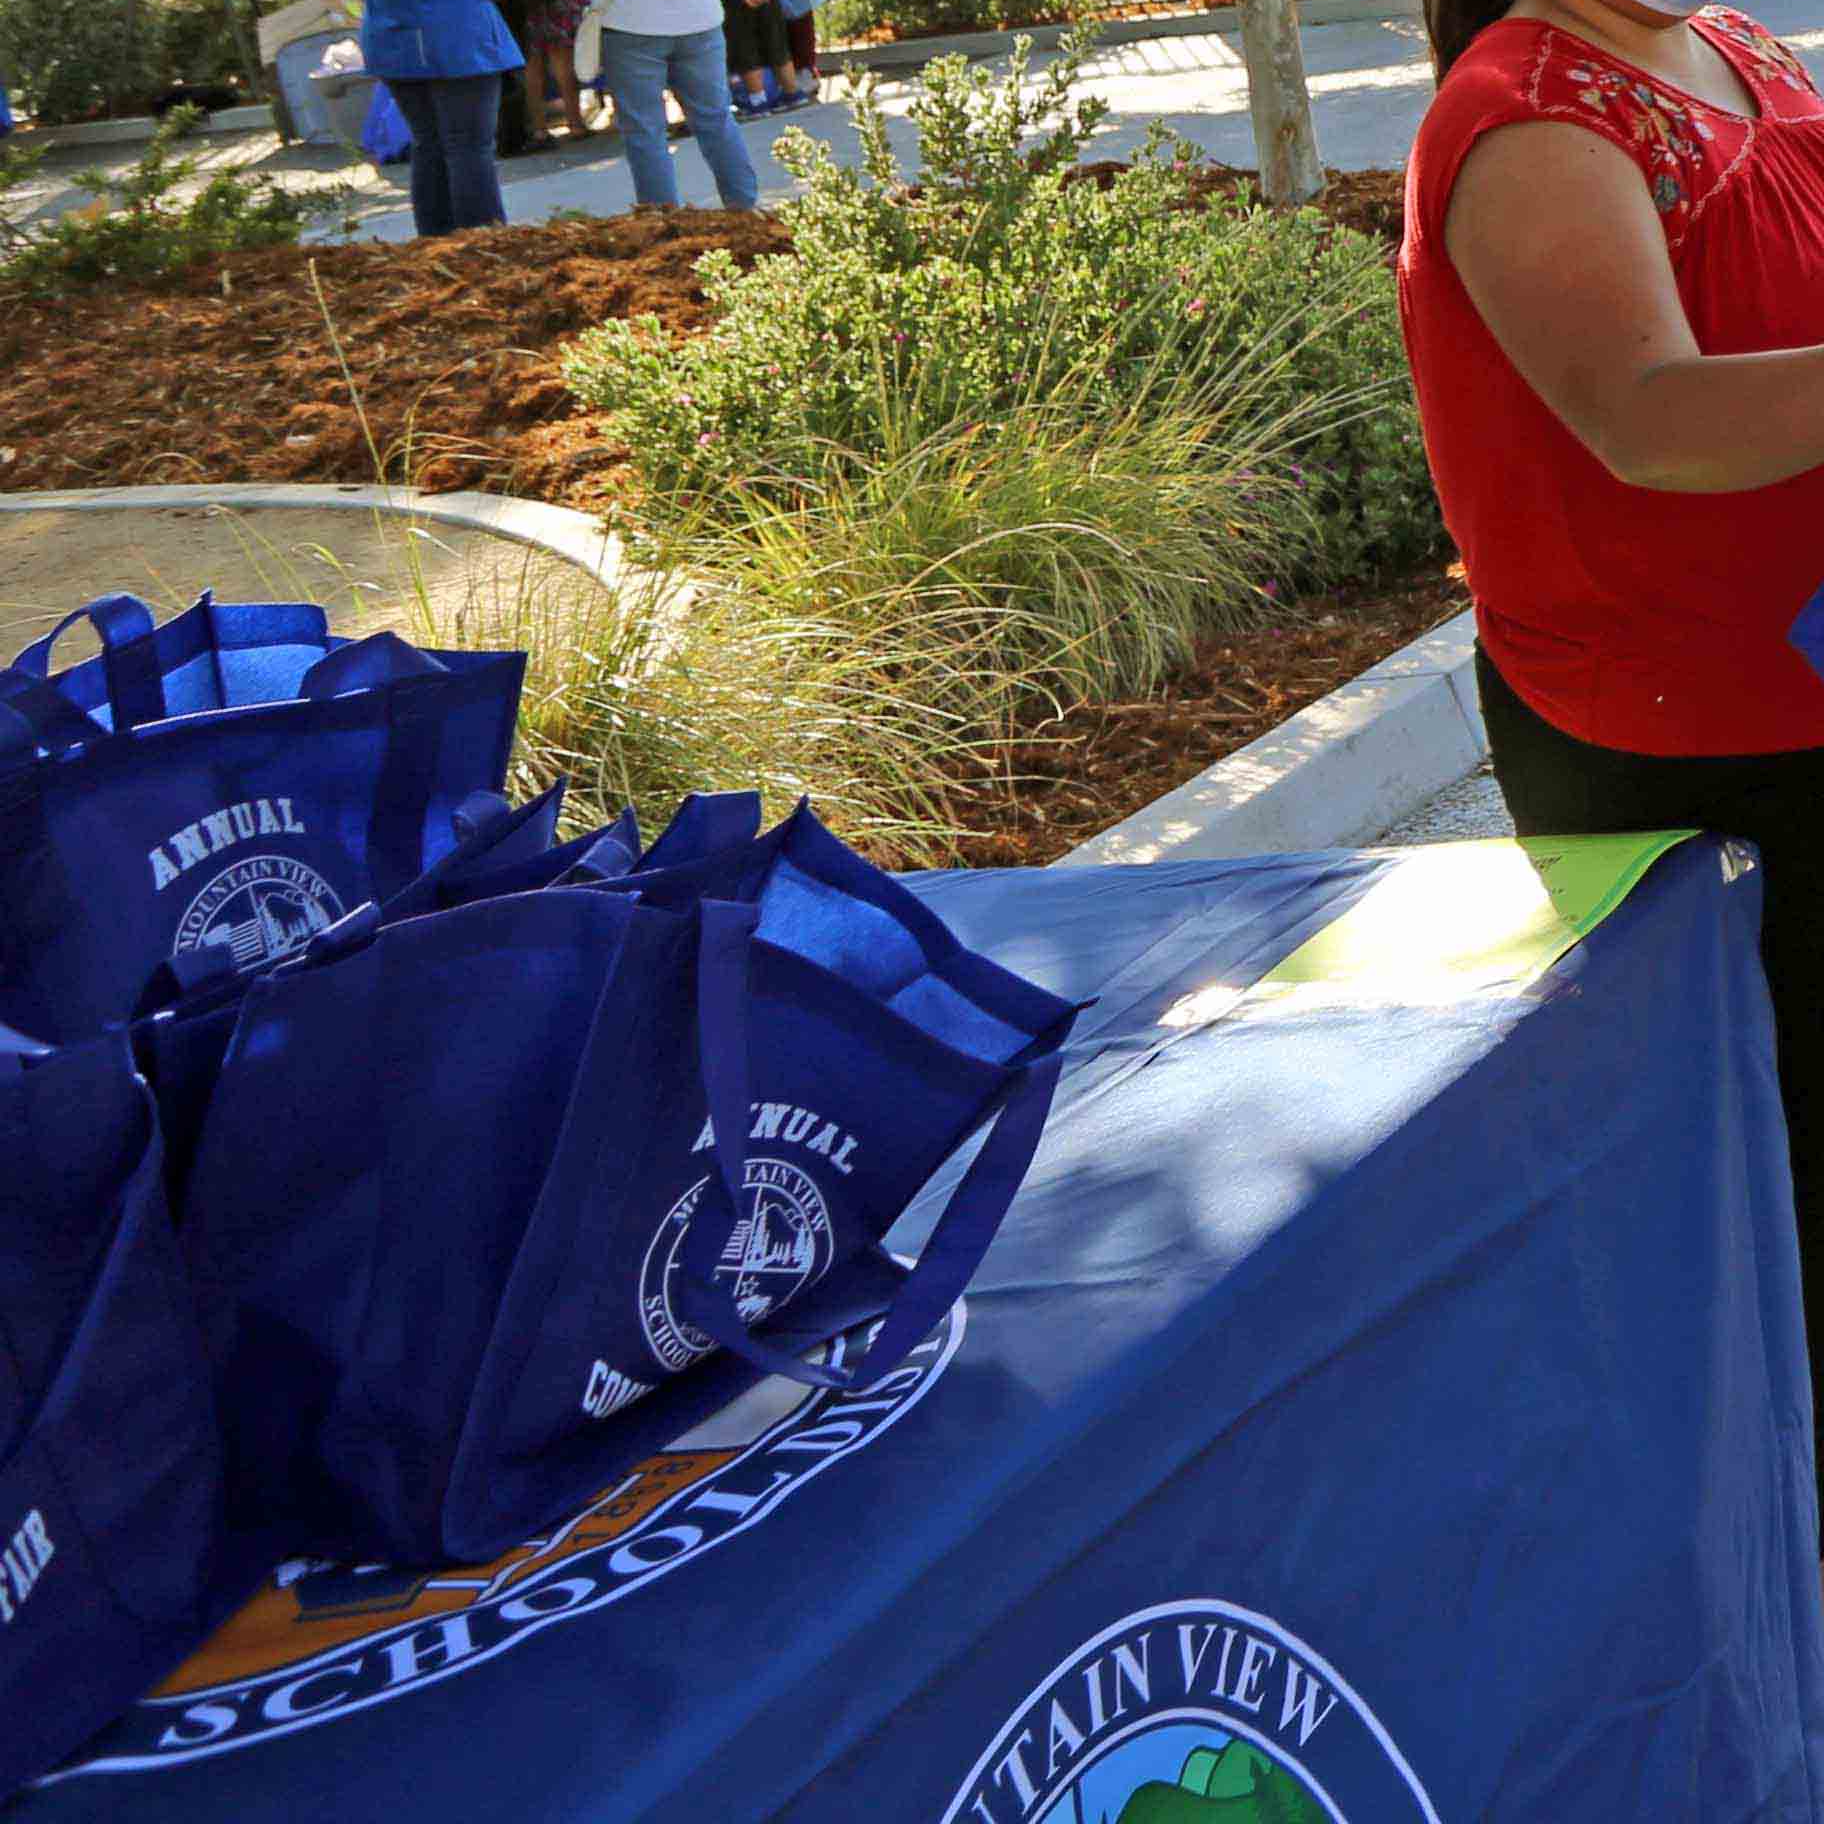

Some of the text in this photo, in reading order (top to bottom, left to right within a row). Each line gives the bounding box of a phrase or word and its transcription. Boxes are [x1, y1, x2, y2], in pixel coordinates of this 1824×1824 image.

[147, 797, 306, 892] ANNUAL
[177, 860, 329, 950] MOUNTAIN VIEW
[690, 1102, 860, 1177] ANUAL
[792, 1176, 829, 1233] VIEW
[155, 1470, 793, 1752] SCHOOL
[1177, 1622, 1339, 1749] VIEW
